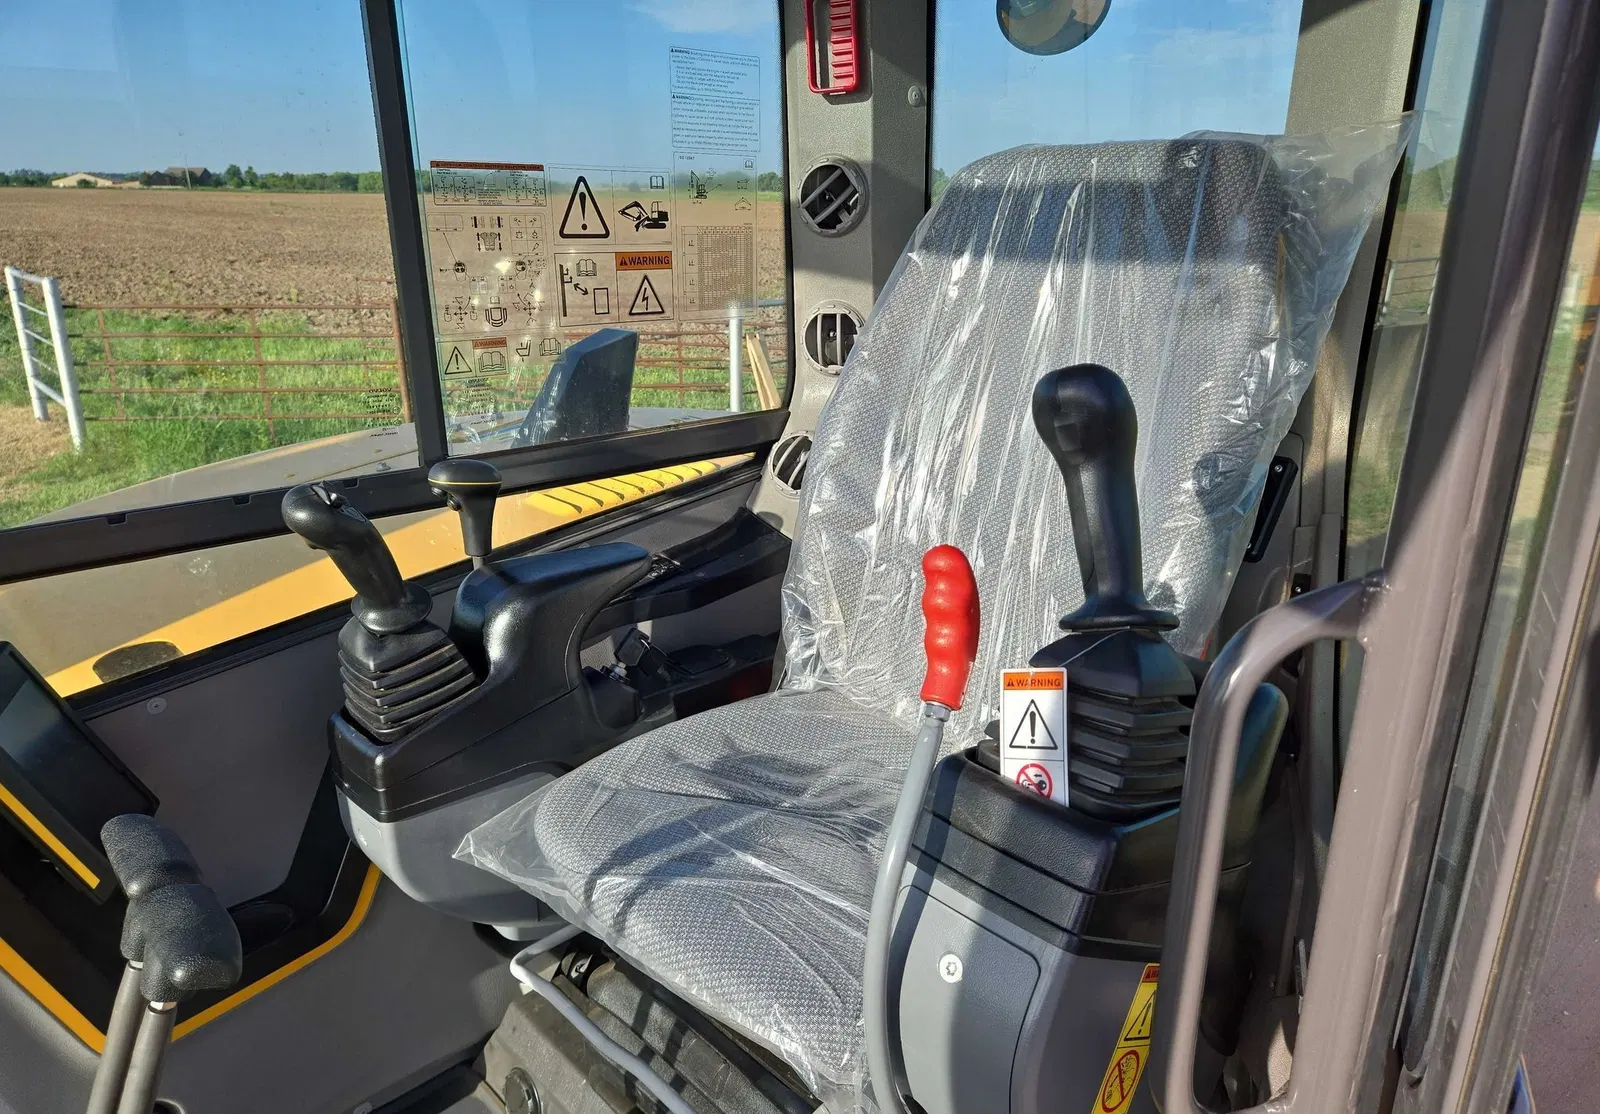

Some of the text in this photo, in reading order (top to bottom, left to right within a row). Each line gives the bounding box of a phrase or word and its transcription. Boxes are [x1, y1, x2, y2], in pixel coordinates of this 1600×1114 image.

[628, 256, 670, 266] WARNING
[479, 339, 506, 347] WARNING
[1016, 678, 1061, 687] WARNING
